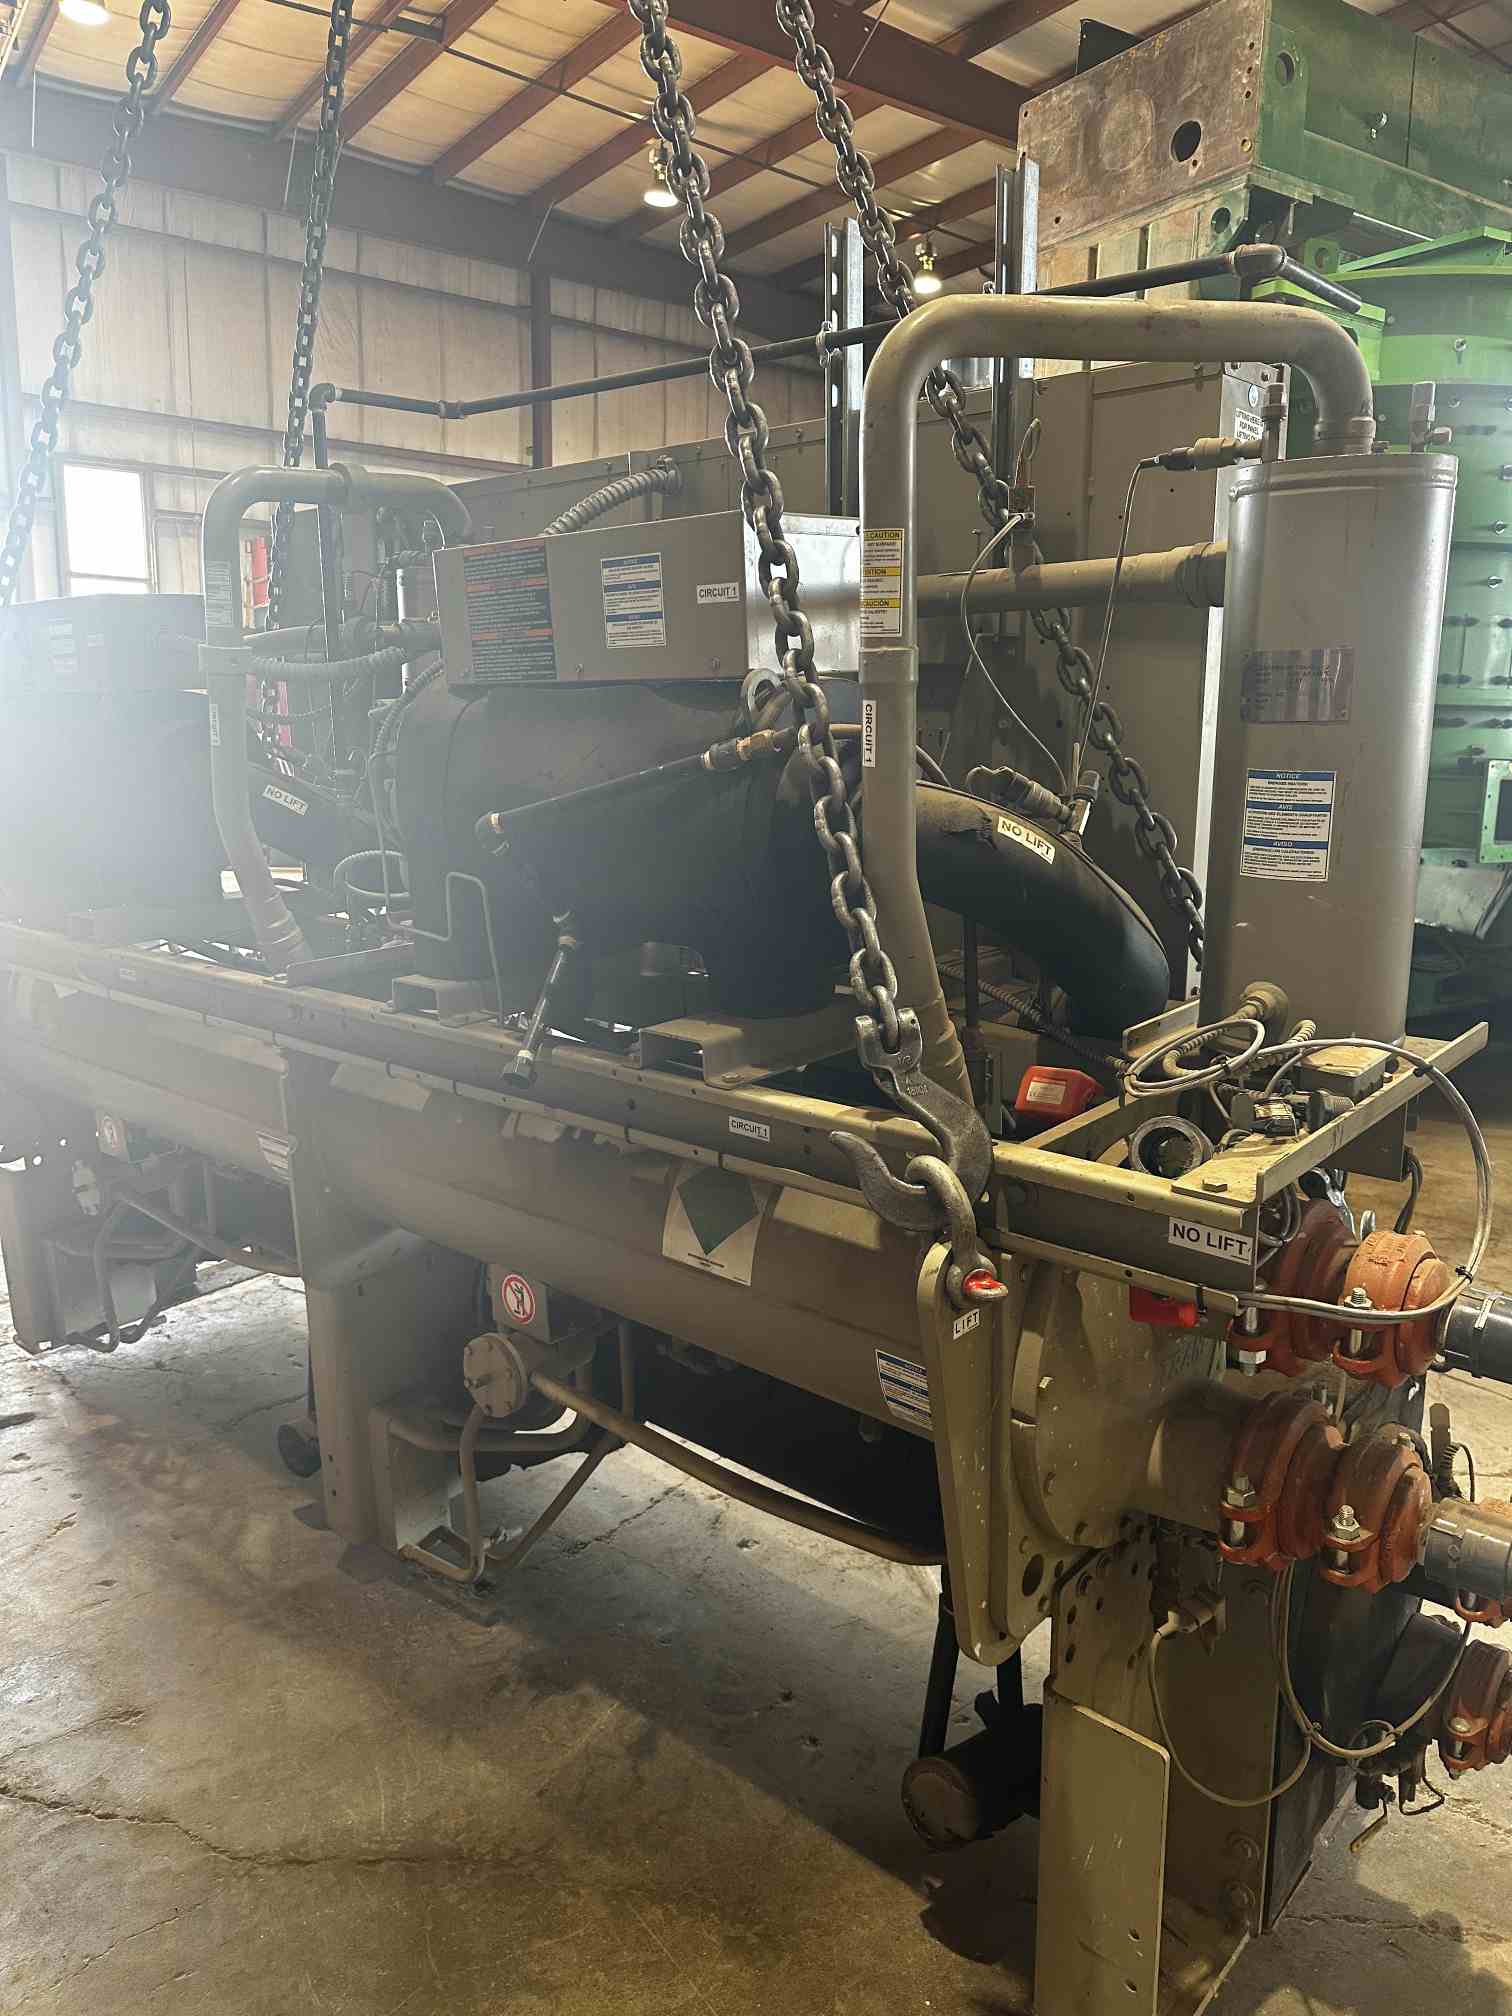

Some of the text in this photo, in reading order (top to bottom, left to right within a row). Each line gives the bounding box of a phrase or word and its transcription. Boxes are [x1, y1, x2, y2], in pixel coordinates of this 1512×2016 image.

[871, 531, 900, 539] CAUTION
[698, 586, 730, 598] CIRCUIT
[865, 703, 873, 754] CIRCUIT
[266, 786, 305, 811] NO LIFT
[1001, 820, 1052, 855] NO LIFT
[731, 1119, 761, 1136] CIRCUIT
[1173, 1222, 1248, 1256] NO LIFT
[955, 1311, 978, 1334] LIFT
